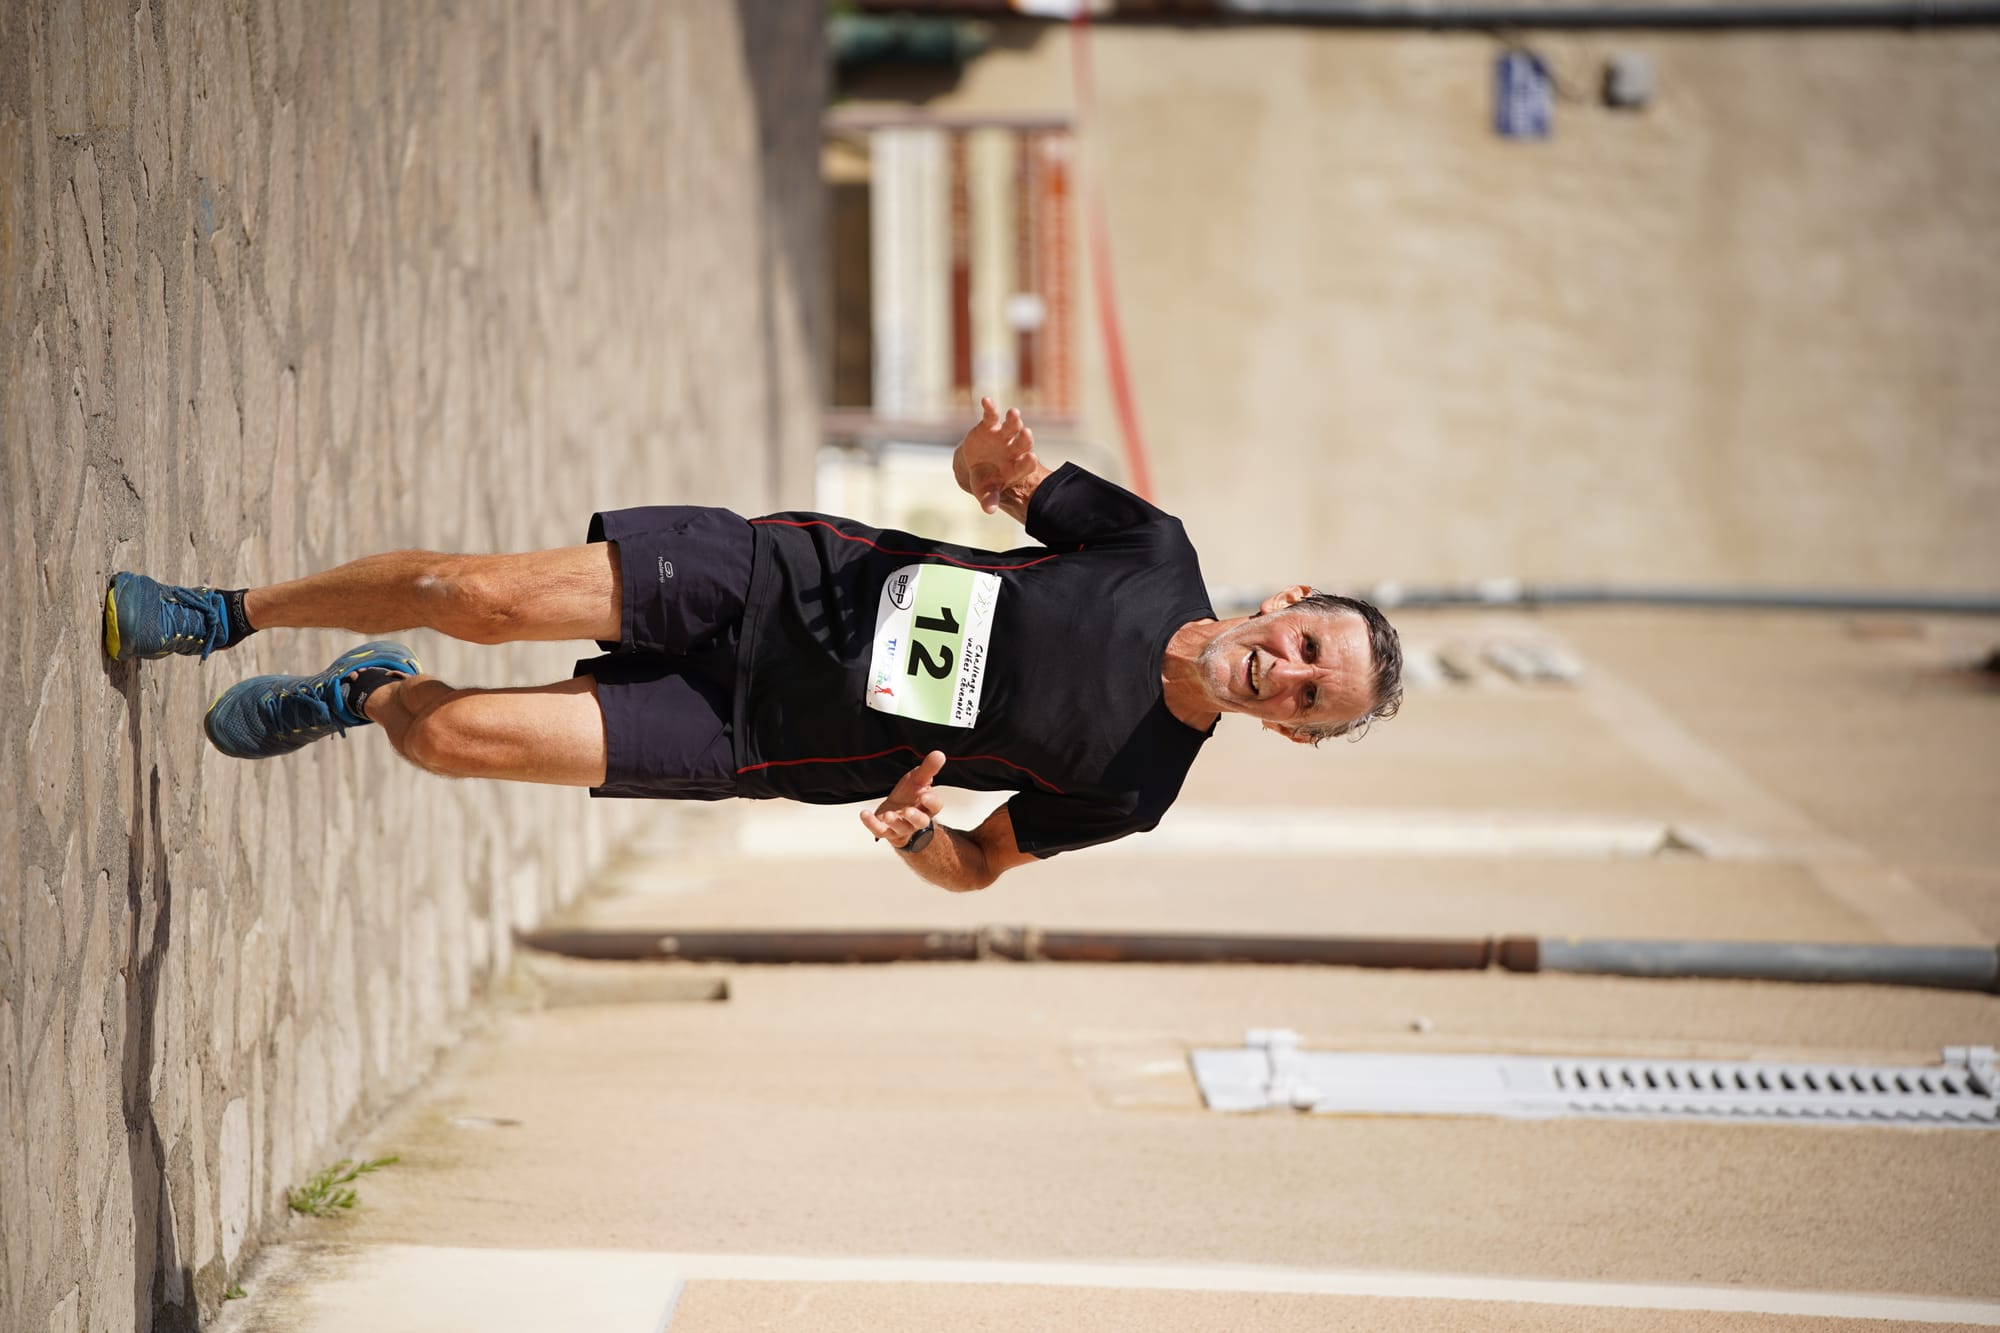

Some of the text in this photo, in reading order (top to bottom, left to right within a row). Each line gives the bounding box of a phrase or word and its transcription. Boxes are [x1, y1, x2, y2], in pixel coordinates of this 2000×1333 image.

[895, 574, 908, 604] BFP
[908, 607, 960, 680] 12
[955, 637, 972, 720] vallées cévenoles
[965, 644, 983, 717] Challenge des
